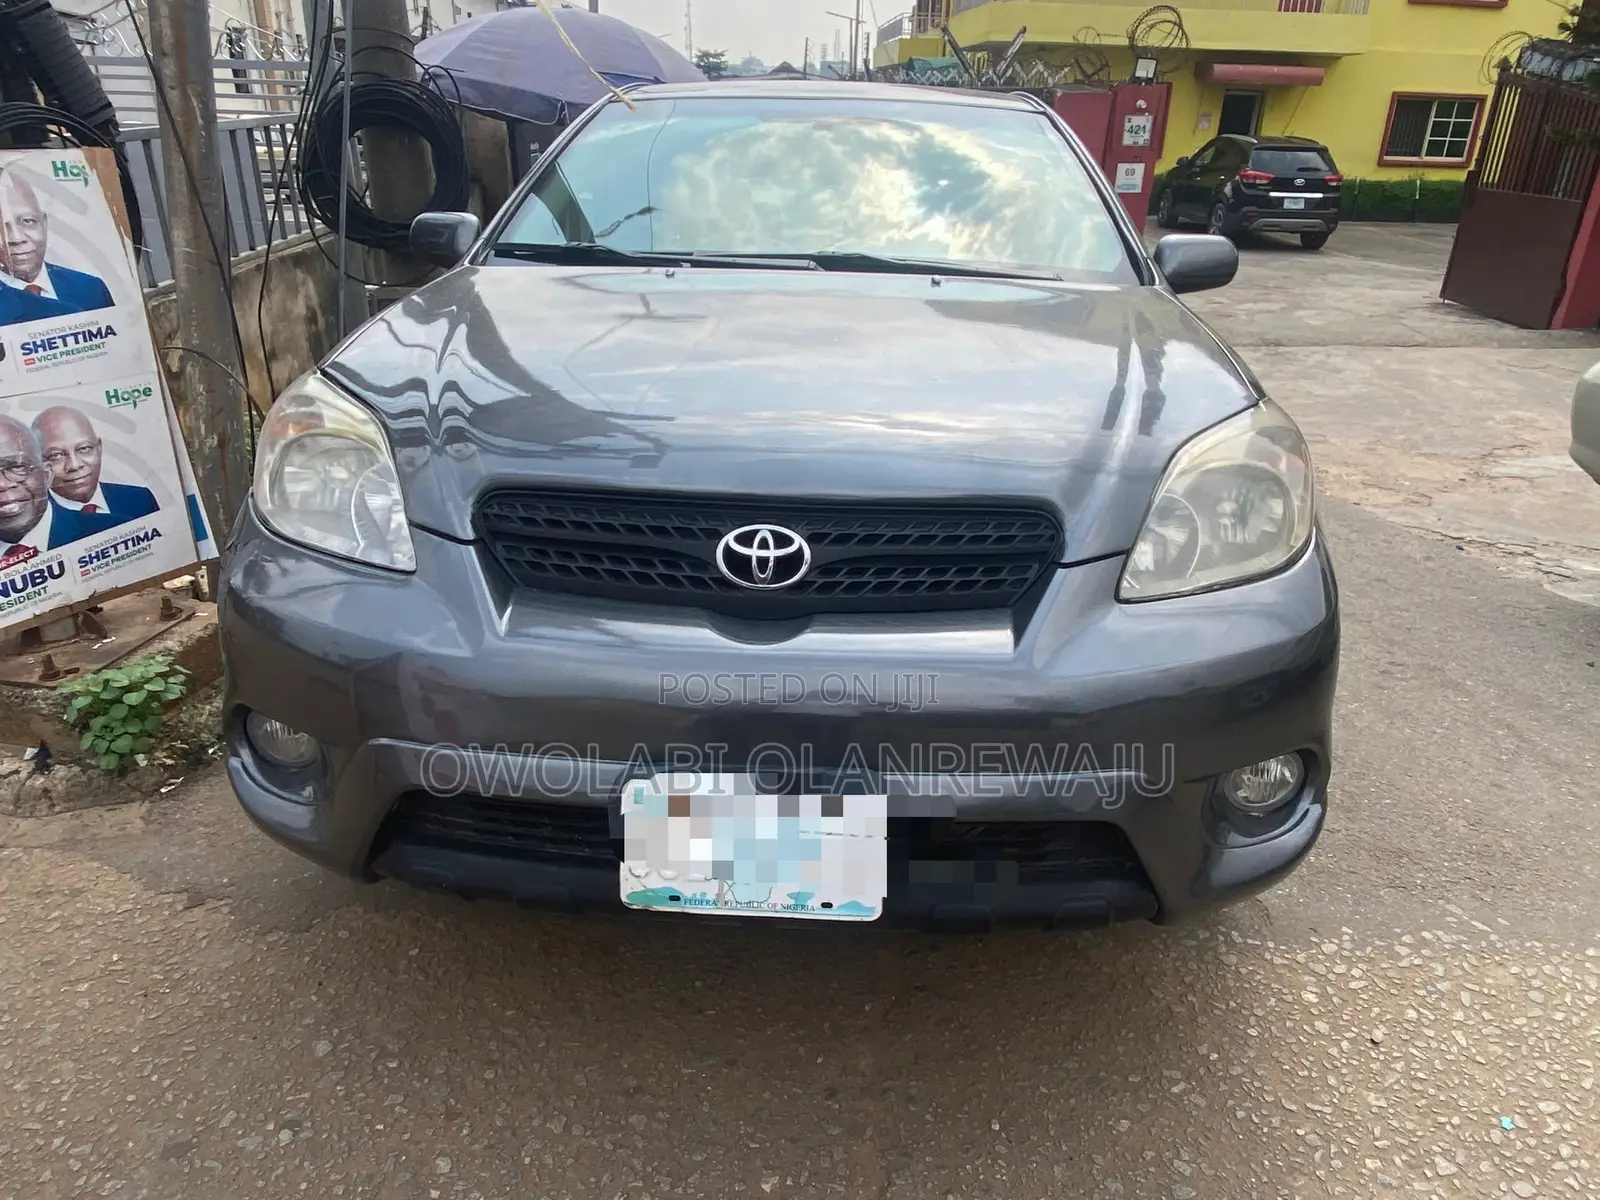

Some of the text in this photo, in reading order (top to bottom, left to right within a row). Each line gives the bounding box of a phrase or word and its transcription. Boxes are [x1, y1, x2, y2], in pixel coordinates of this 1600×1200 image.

[1127, 124, 1146, 135] 421
[1125, 168, 1136, 176] 69
[20, 324, 118, 356] SHETTIMA
[28, 320, 100, 340] SENATOR KASHIM
[36, 352, 58, 363] VICE
[59, 341, 106, 358] PRESIDENT
[105, 386, 153, 410] Hope
[77, 528, 162, 569] SHETTIMA
[84, 525, 146, 554] SENATOR KASHIM
[4, 553, 62, 579] BOLA AHMED
[91, 561, 111, 573] VICE
[111, 543, 152, 565] PRESIDENT
[684, 898, 816, 912] FEDERA REPUBLIC OF NIGERIA
